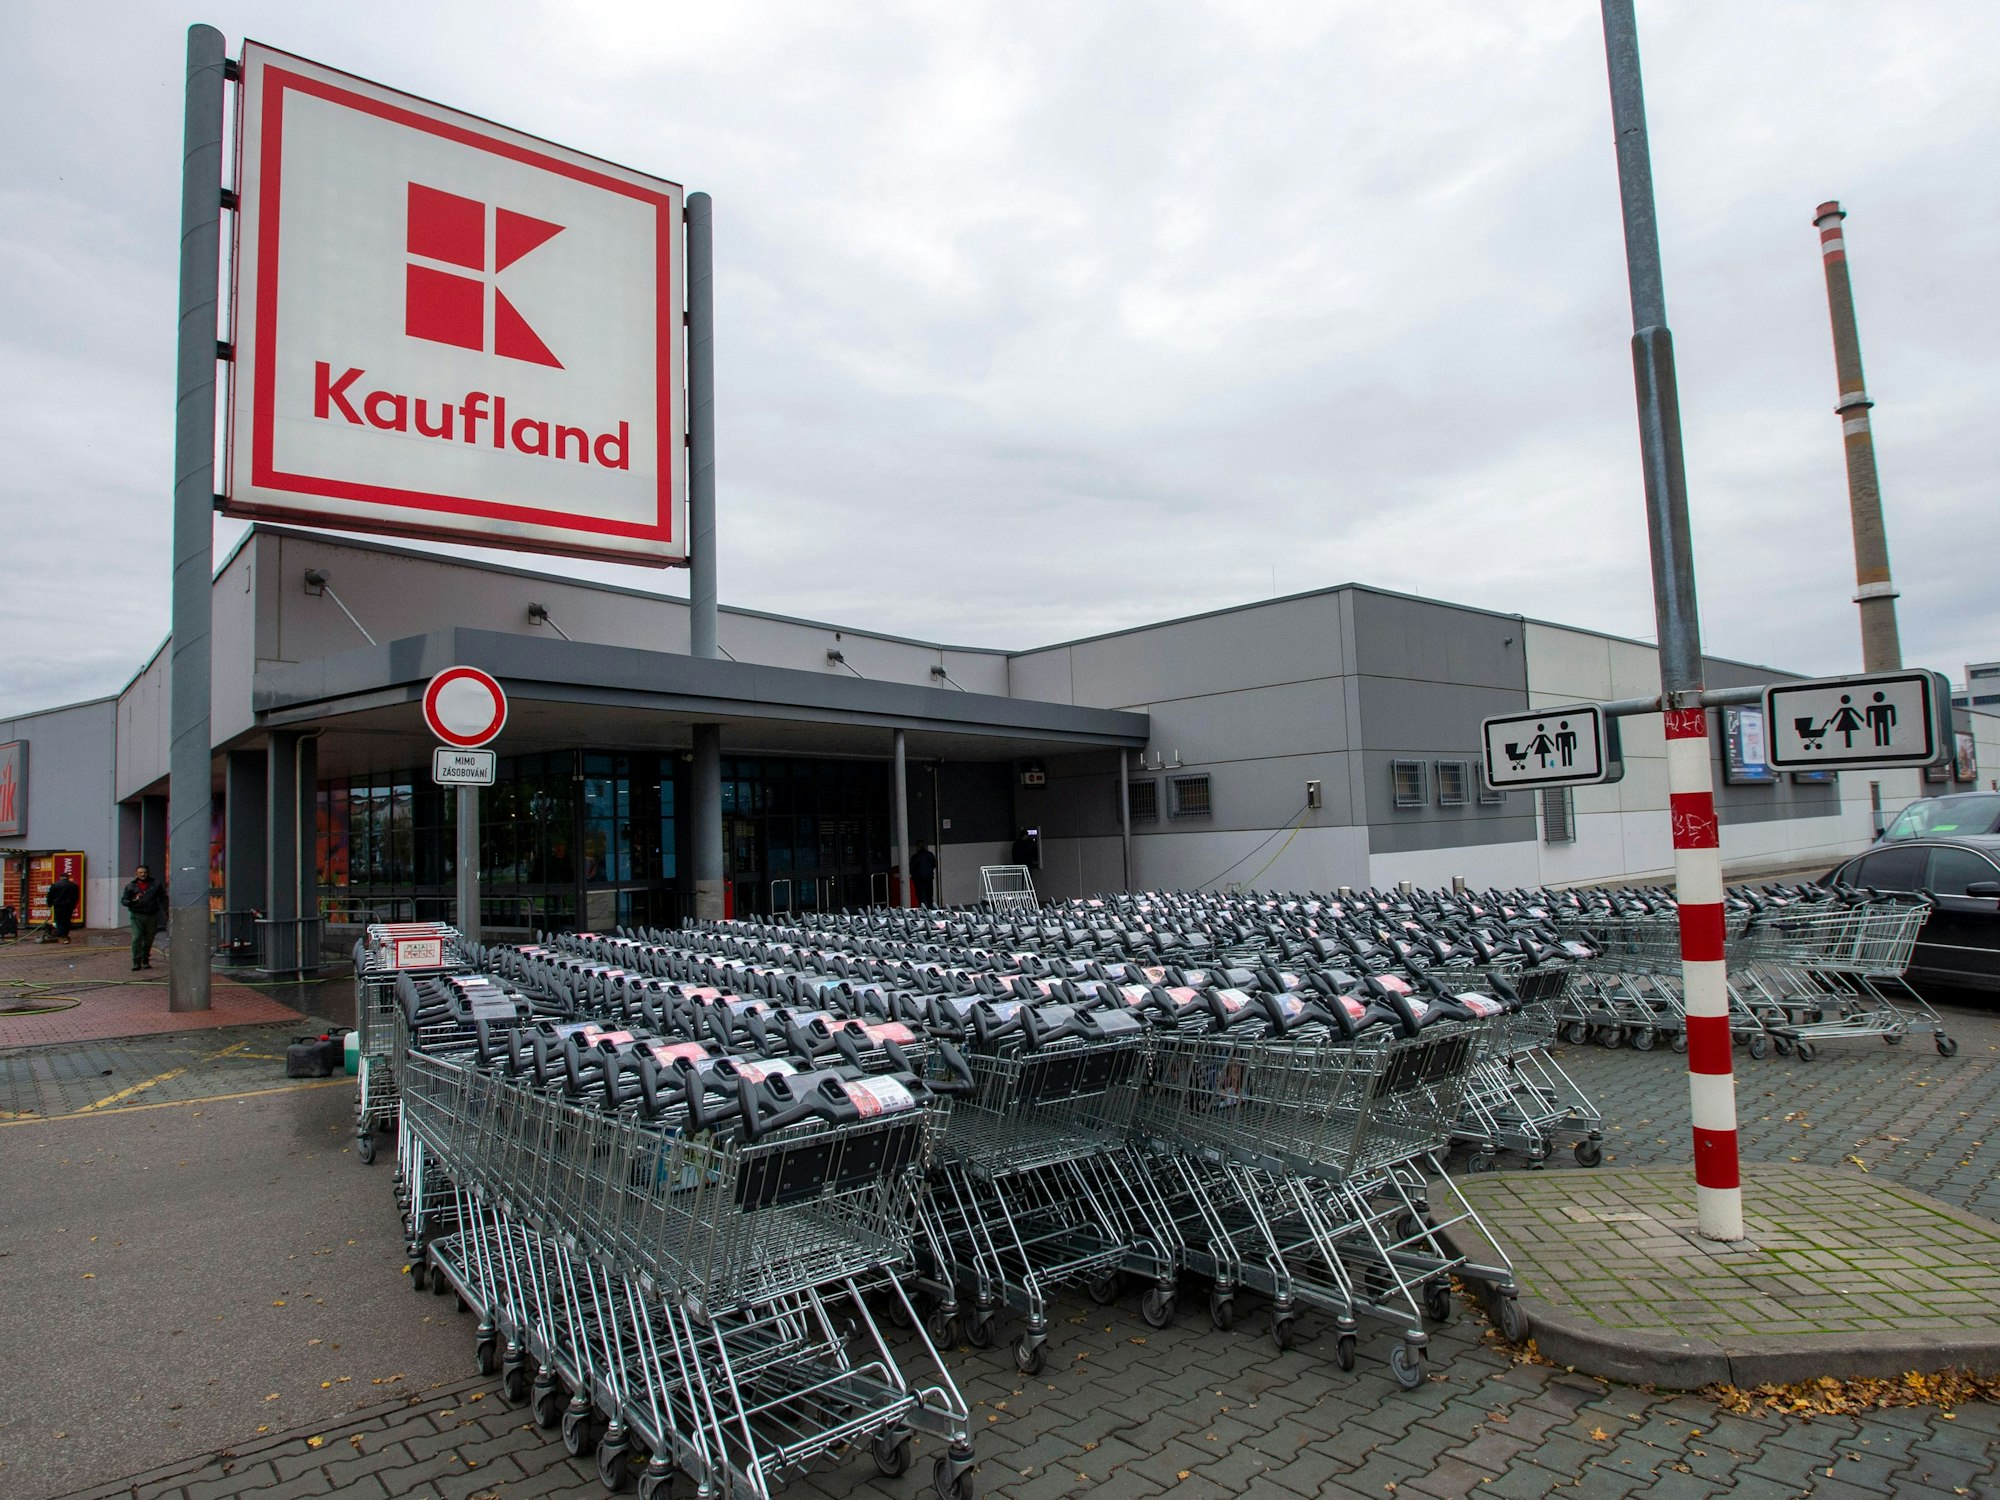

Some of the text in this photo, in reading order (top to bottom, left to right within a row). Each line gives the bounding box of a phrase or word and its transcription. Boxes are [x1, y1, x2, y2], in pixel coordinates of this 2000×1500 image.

[313, 360, 630, 471] Kaufland
[455, 756, 475, 766] MIMO
[442, 766, 489, 778] ZÁSOBOVÁNÍ
